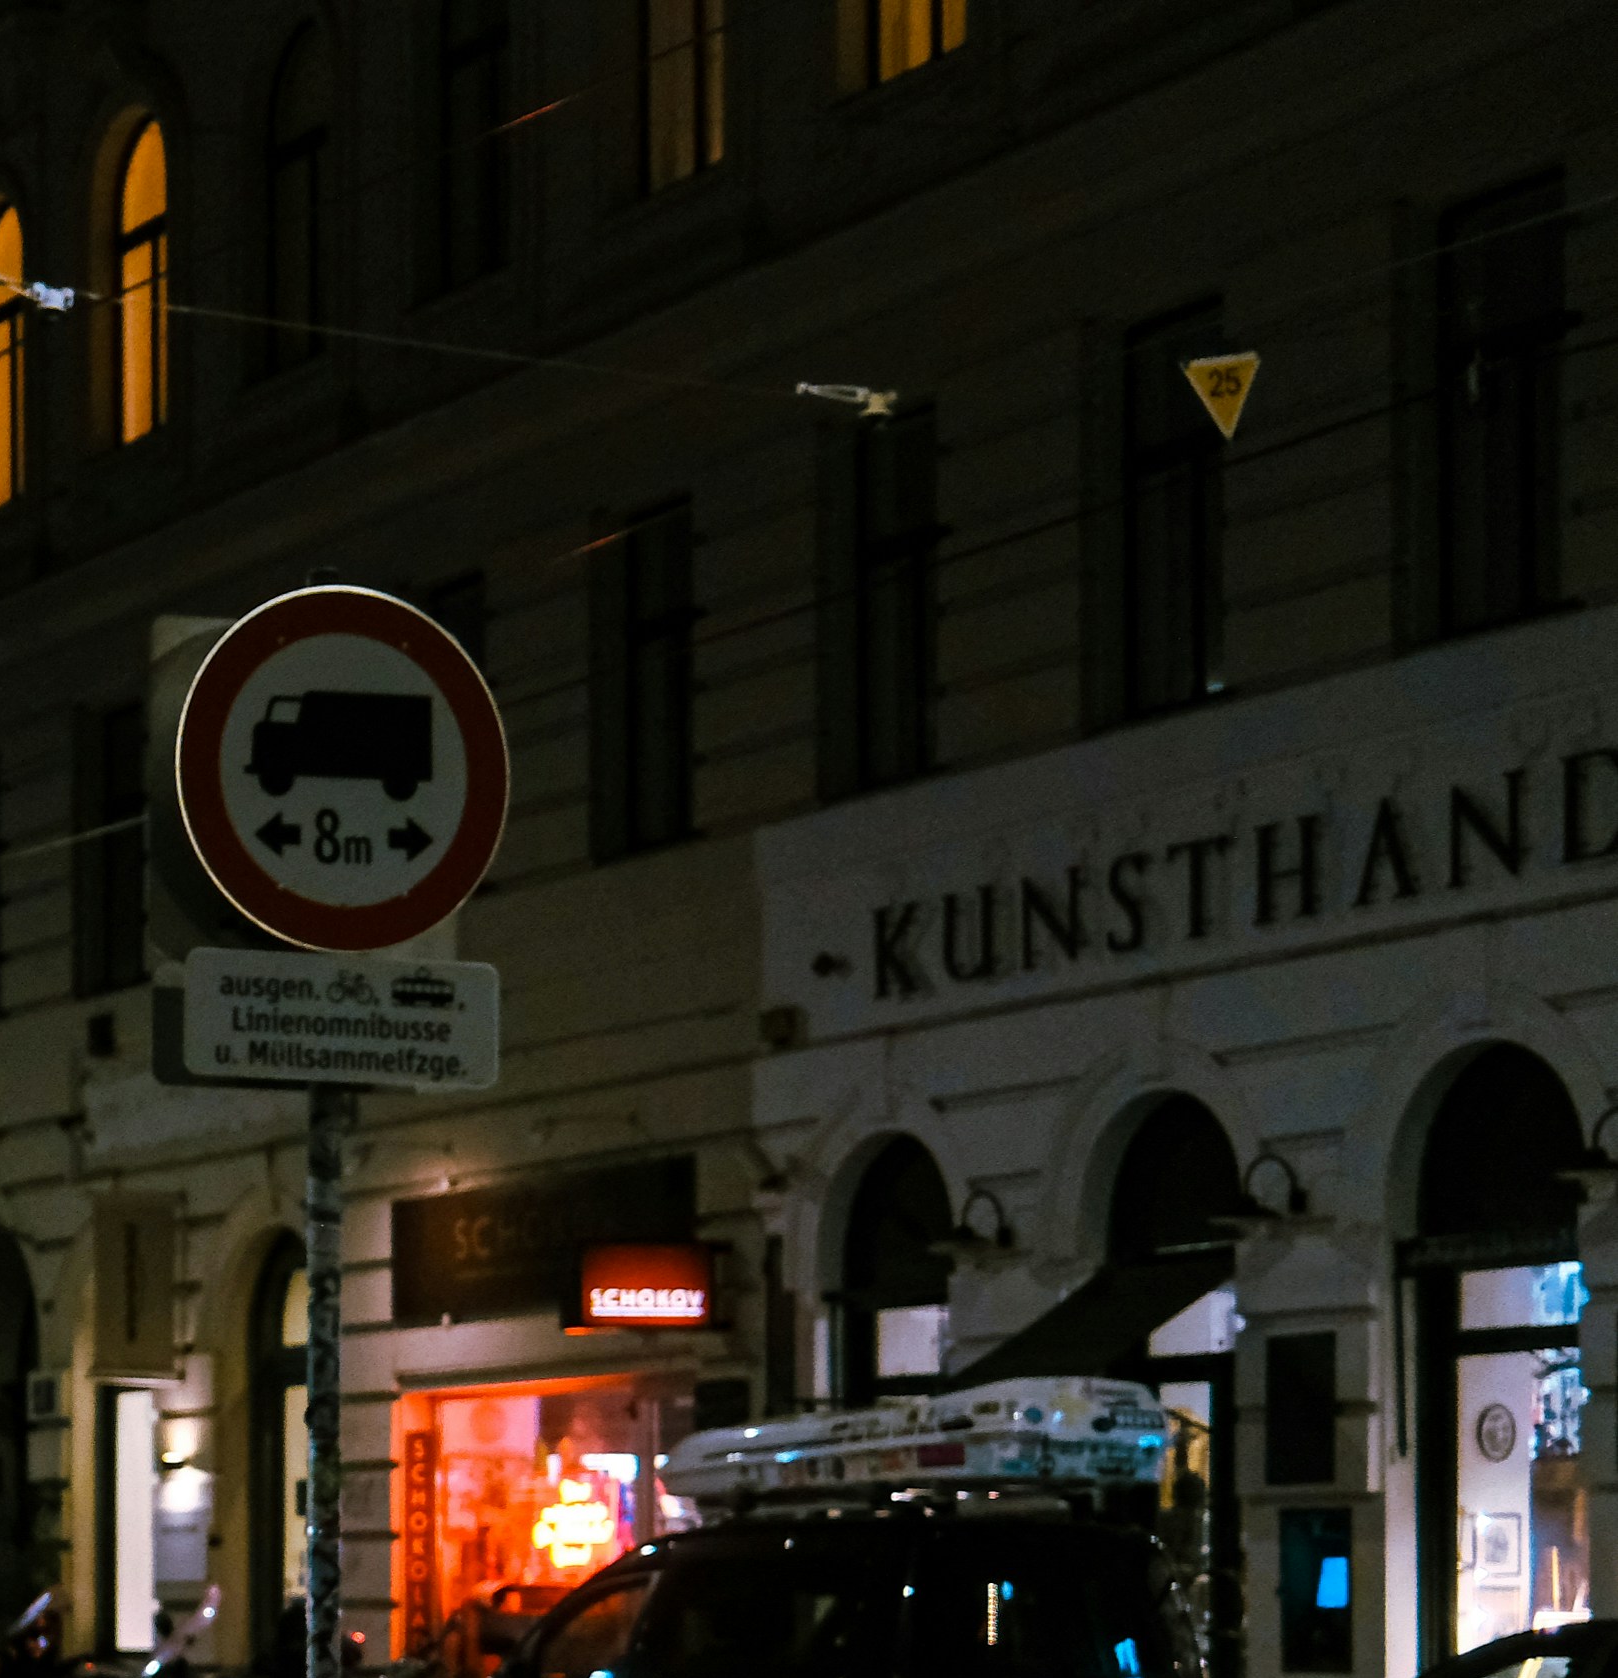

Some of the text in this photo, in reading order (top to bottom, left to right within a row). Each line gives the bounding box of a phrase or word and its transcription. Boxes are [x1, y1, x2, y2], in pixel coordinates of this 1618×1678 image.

[1209, 366, 1241, 397] 25
[316, 809, 371, 864] 8m
[219, 974, 322, 1005] ausgen.
[231, 1005, 452, 1043] Linienomnibusse
[216, 1040, 467, 1080] u. Müllsammelfzge.
